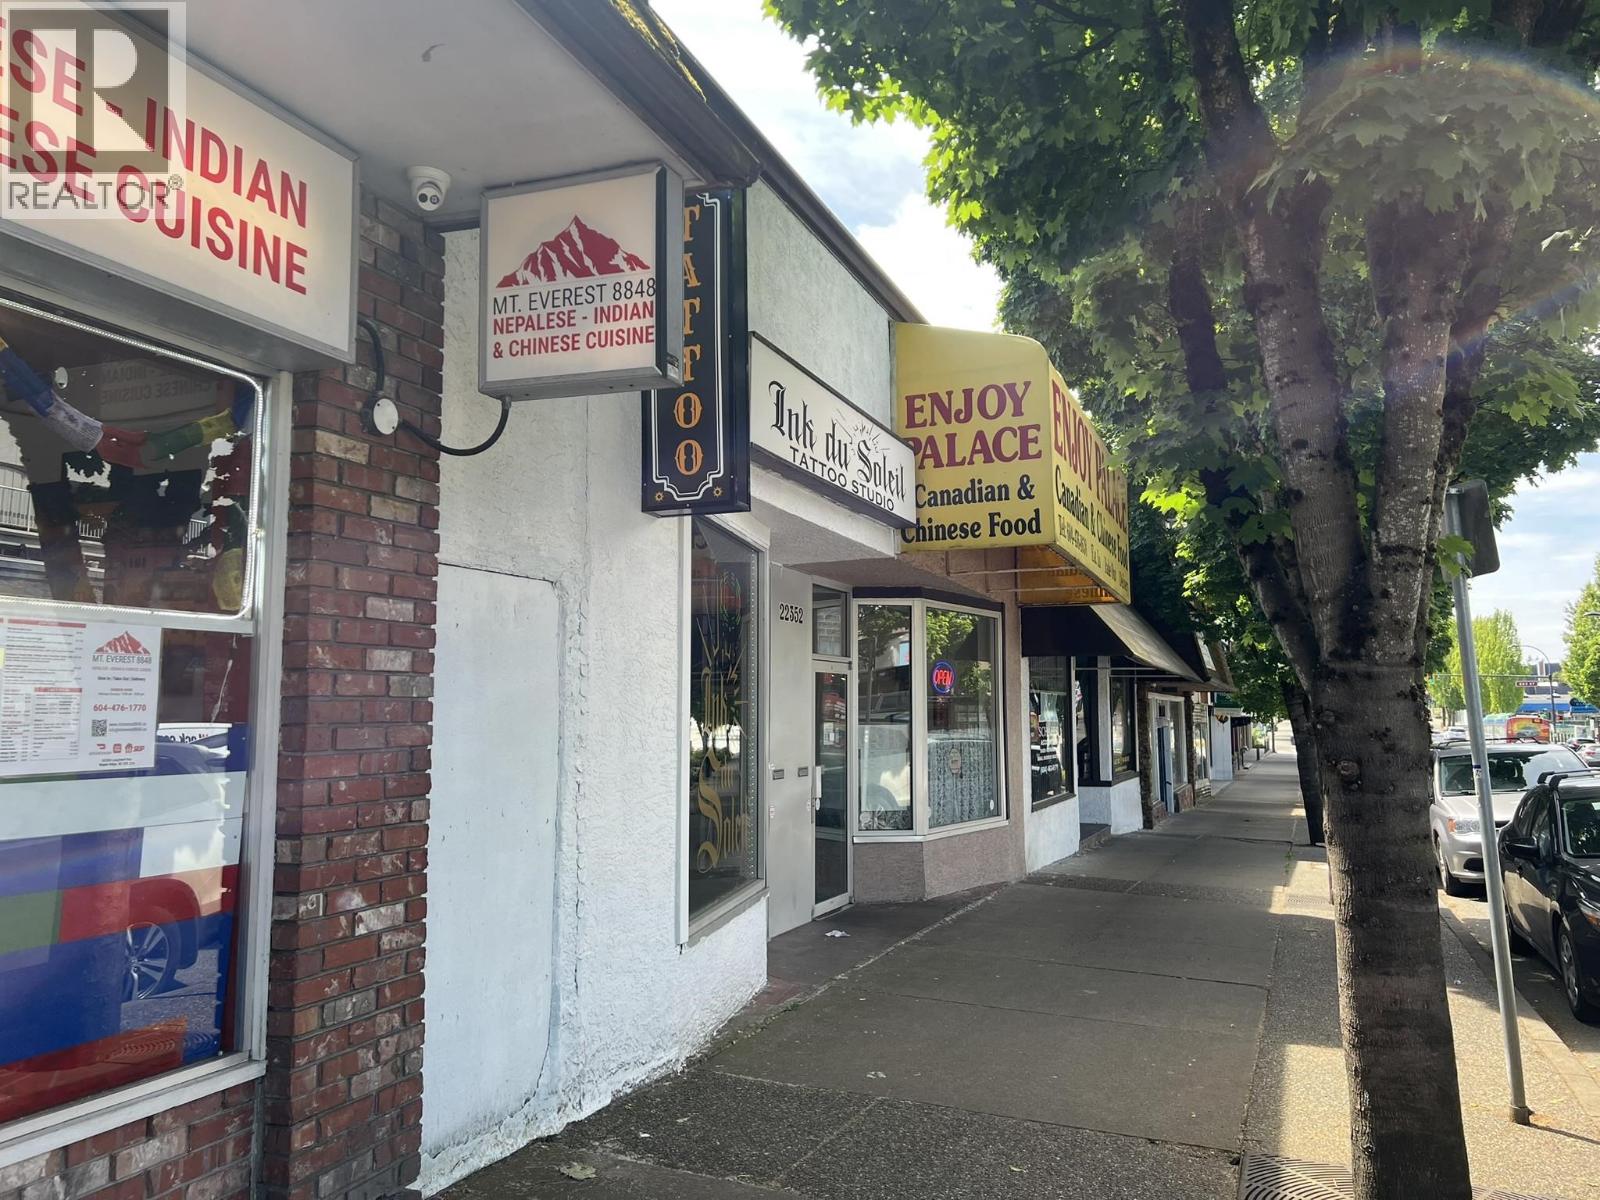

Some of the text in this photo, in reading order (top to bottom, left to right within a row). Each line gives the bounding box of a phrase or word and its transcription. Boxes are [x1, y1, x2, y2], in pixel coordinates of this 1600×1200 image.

[0, 17, 86, 117] SE
[145, 97, 308, 229] INDIAN
[116, 165, 308, 296] CUISINE
[493, 277, 656, 315] MT. EVEREST 8848
[493, 311, 577, 335] NEPALESE
[594, 301, 655, 325] INDIAN
[493, 326, 655, 359] & CHINESE CUISINE
[904, 381, 1032, 429] ENJOY
[768, 380, 817, 453] Ink
[857, 440, 906, 502] Soleil
[904, 424, 1043, 470] PALACE
[1052, 379, 1093, 491] ENJOY
[790, 445, 895, 511] TATTOO STUDIO
[915, 474, 1036, 508] Canadian &
[1055, 464, 1090, 530] Canadian
[900, 508, 1041, 543] Chinese Food
[779, 603, 804, 624] 22352
[106, 656, 135, 664] EVEREST
[935, 669, 953, 686] OPEN
